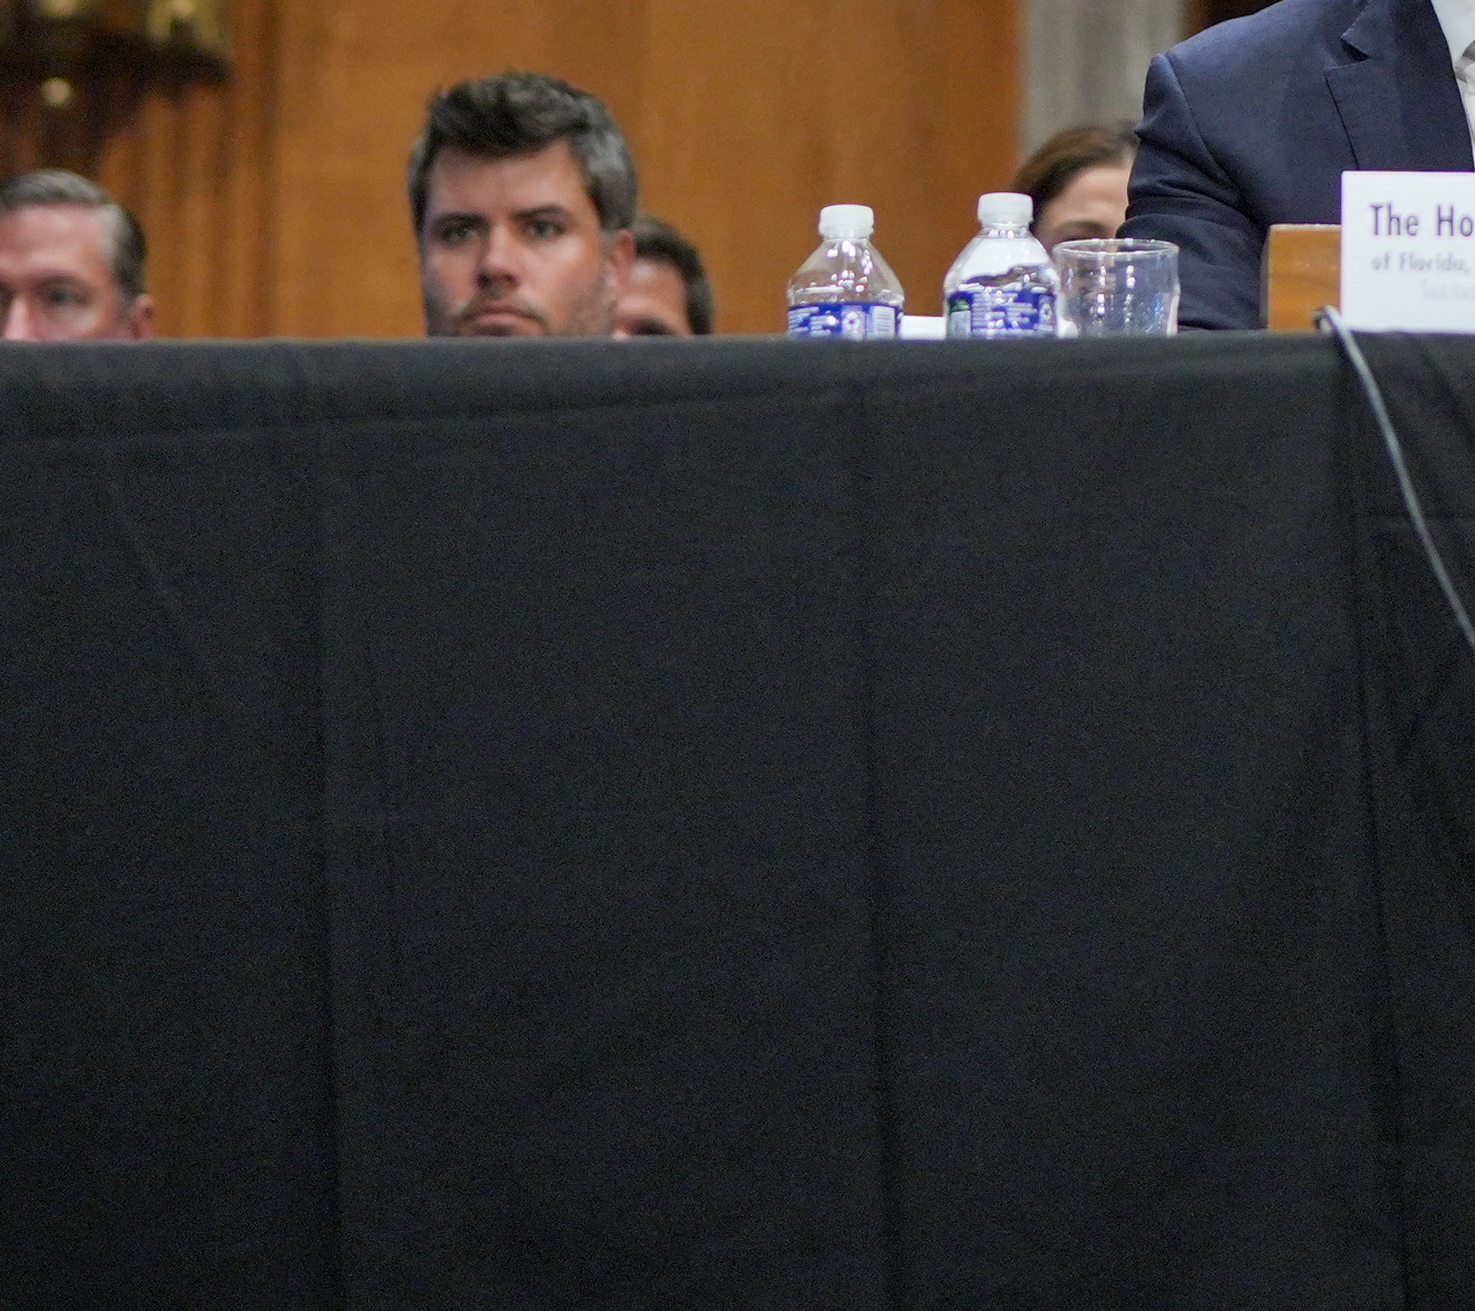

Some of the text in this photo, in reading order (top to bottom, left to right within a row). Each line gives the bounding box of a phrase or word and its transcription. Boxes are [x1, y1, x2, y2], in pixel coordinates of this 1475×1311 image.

[1369, 201, 1420, 237] The
[1371, 251, 1391, 271] of
[1398, 251, 1471, 275] Florida,
